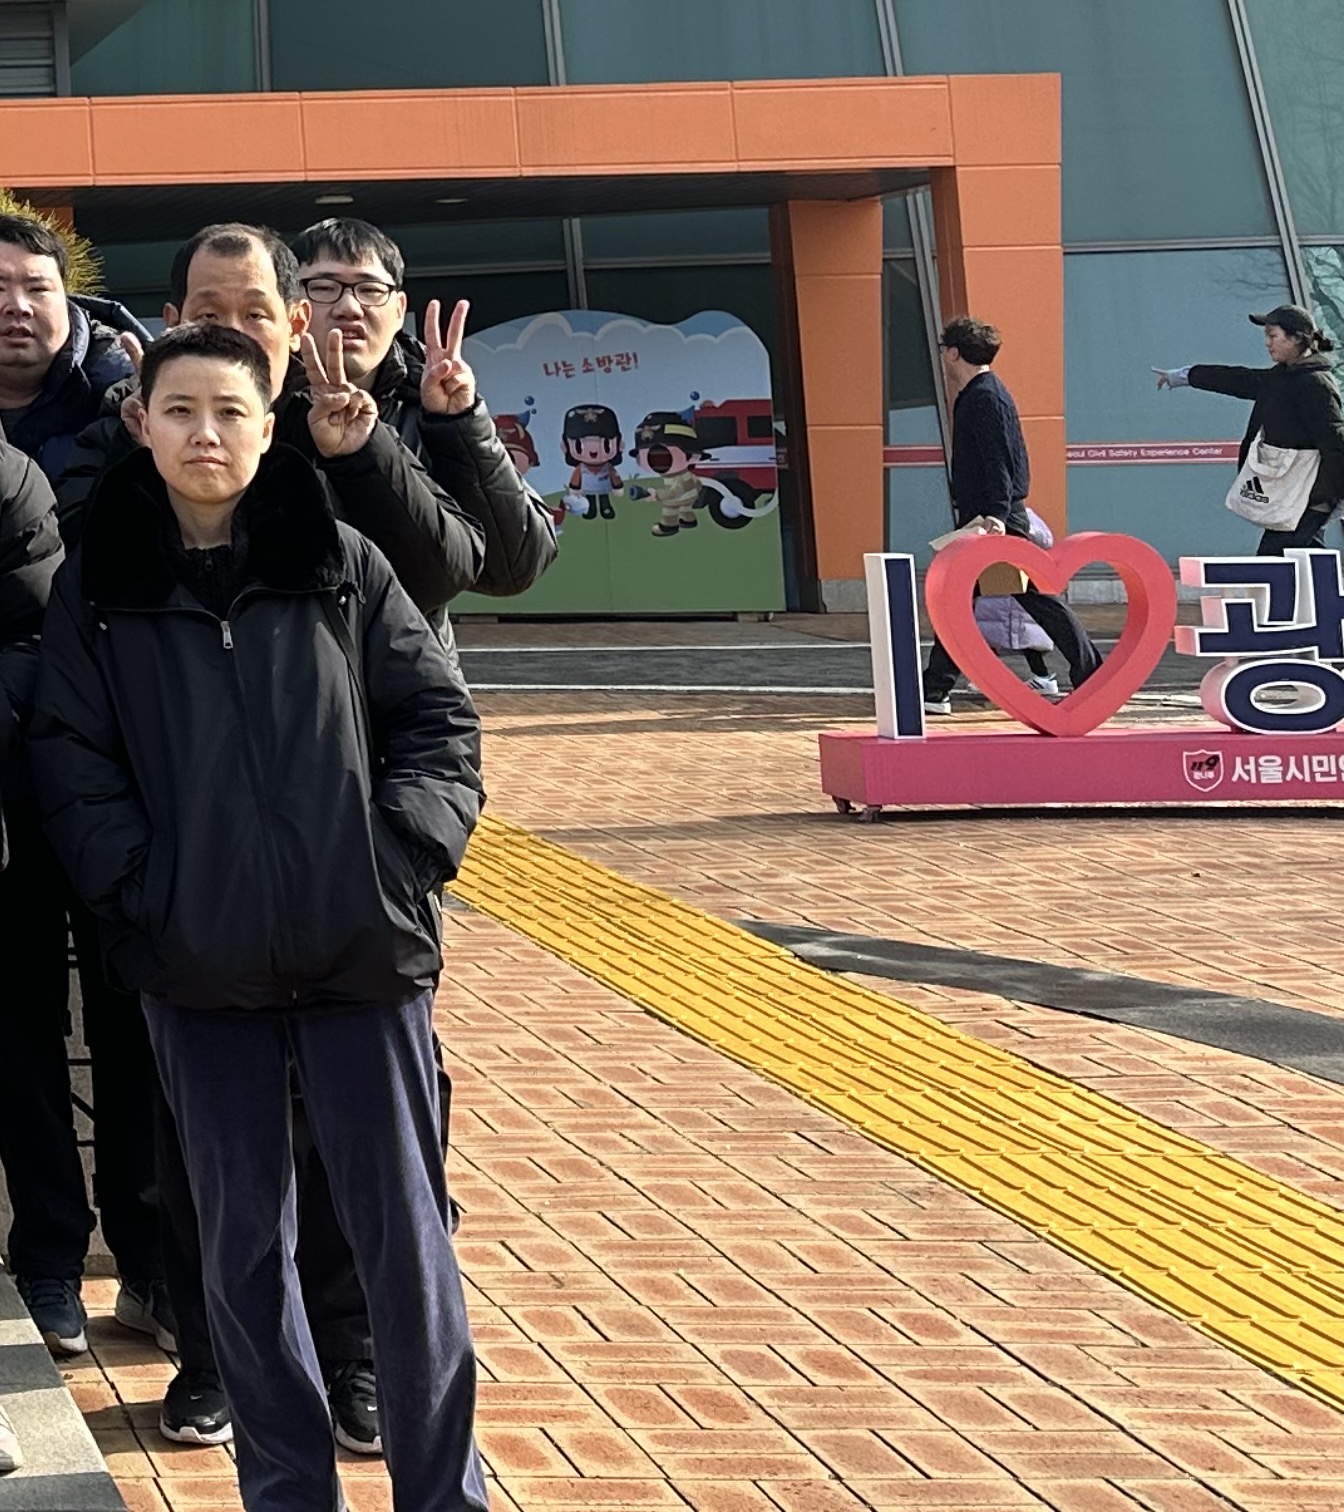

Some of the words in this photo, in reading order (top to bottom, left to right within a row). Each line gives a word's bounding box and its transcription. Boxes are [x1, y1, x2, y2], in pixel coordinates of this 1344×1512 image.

[542, 359, 576, 379] 나는
[581, 352, 639, 374] 소방관!
[1231, 754, 1344, 784] 서울시민
